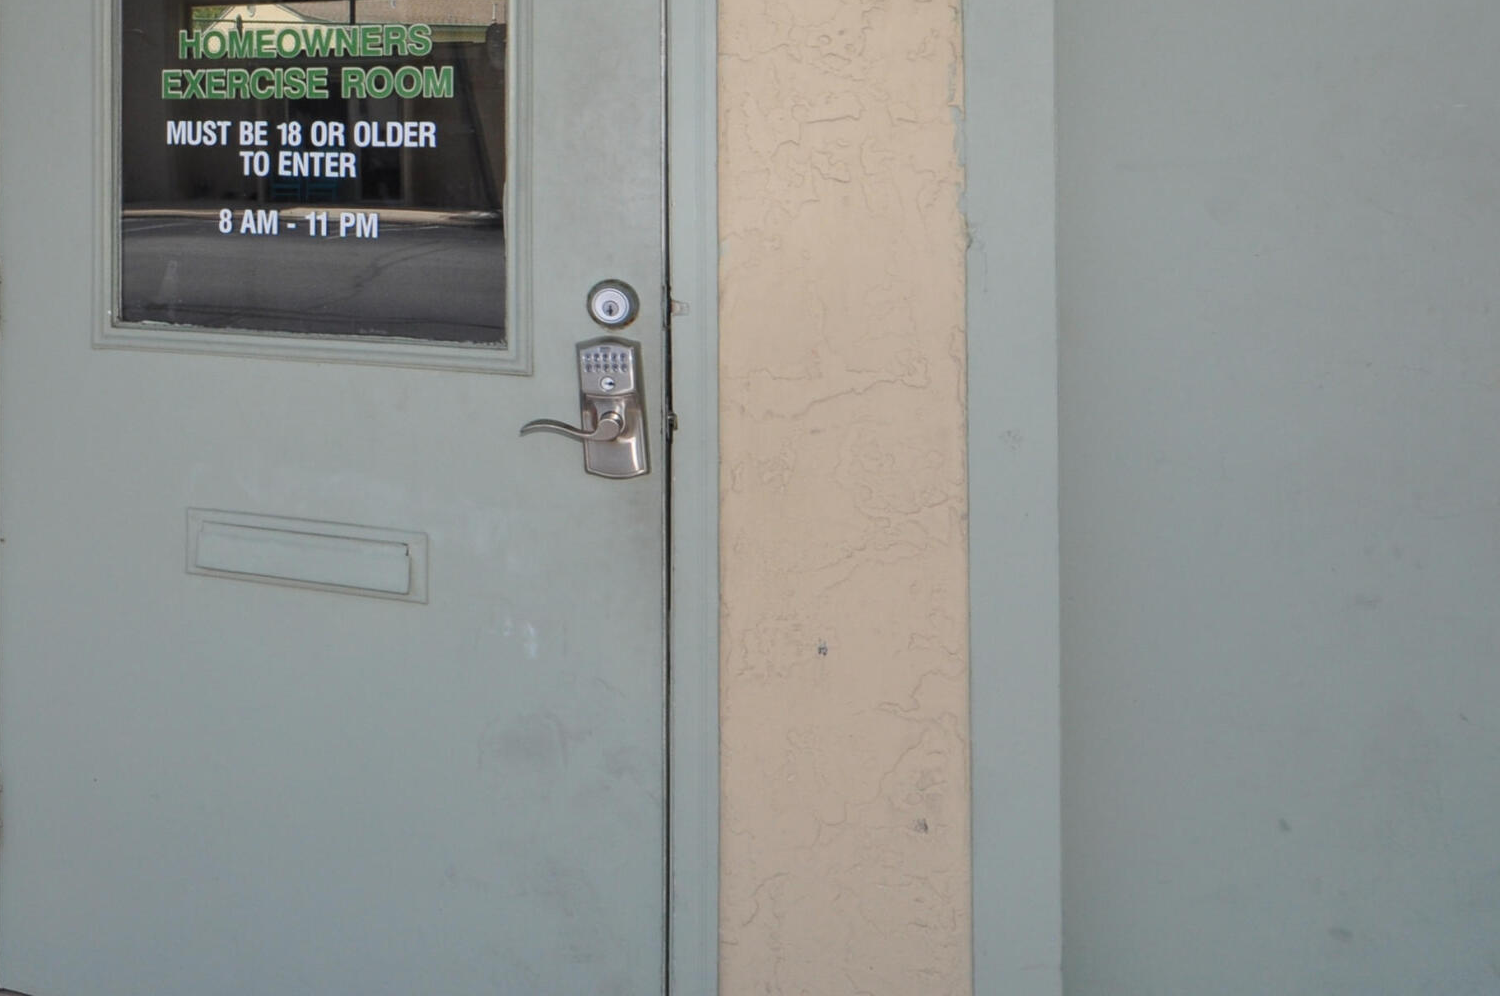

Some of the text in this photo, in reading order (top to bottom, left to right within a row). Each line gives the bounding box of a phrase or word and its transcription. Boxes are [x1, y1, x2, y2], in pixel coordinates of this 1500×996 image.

[179, 23, 433, 60] HOMEOWNERS
[161, 66, 455, 100] EXERCISE ROOM
[166, 120, 437, 148] MUST BE 18 OR OLDER
[239, 151, 357, 178] TO ENTER
[218, 208, 232, 234] 8
[240, 209, 278, 235] AM
[305, 211, 328, 237] 11
[339, 212, 379, 239] PM
